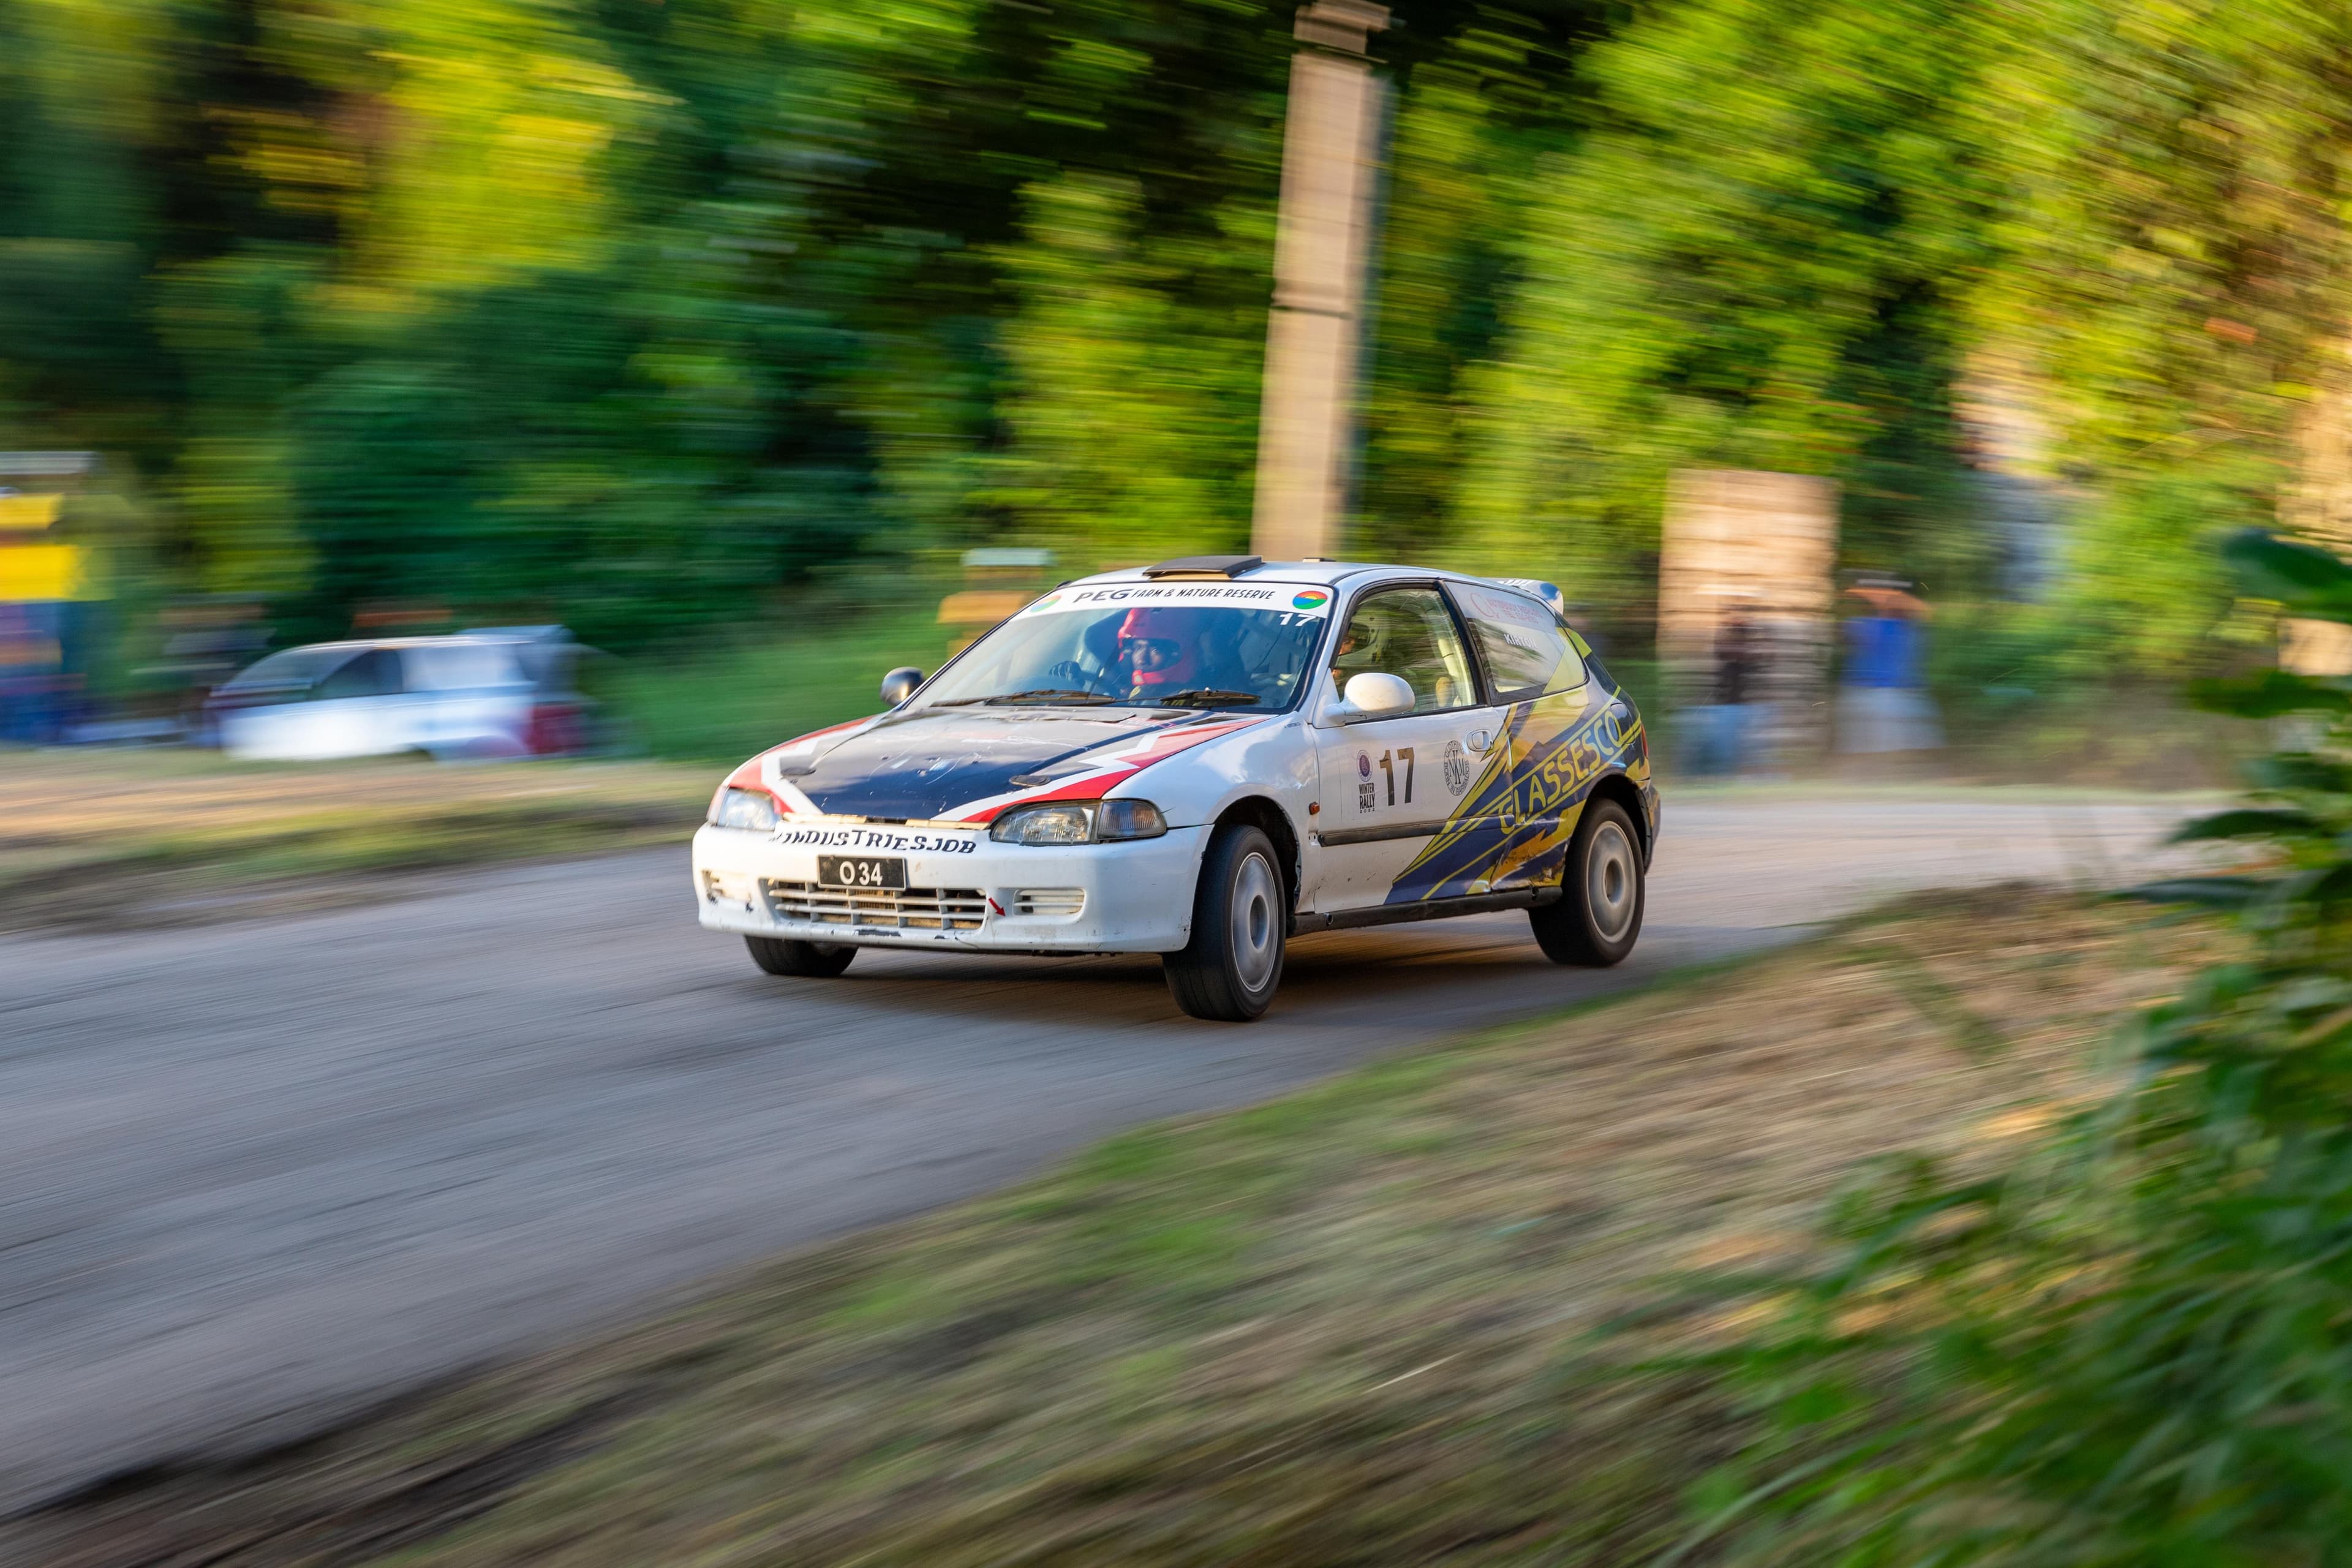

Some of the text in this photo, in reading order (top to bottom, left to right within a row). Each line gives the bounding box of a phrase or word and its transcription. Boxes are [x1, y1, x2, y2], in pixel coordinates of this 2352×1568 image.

[1072, 588, 1276, 603] PEG FARM & NATURE RESERVE
[1279, 612, 1317, 627] 17
[1379, 747, 1415, 807] 17
[1359, 782, 1375, 794] WINTER
[1359, 793, 1376, 810] RALLY
